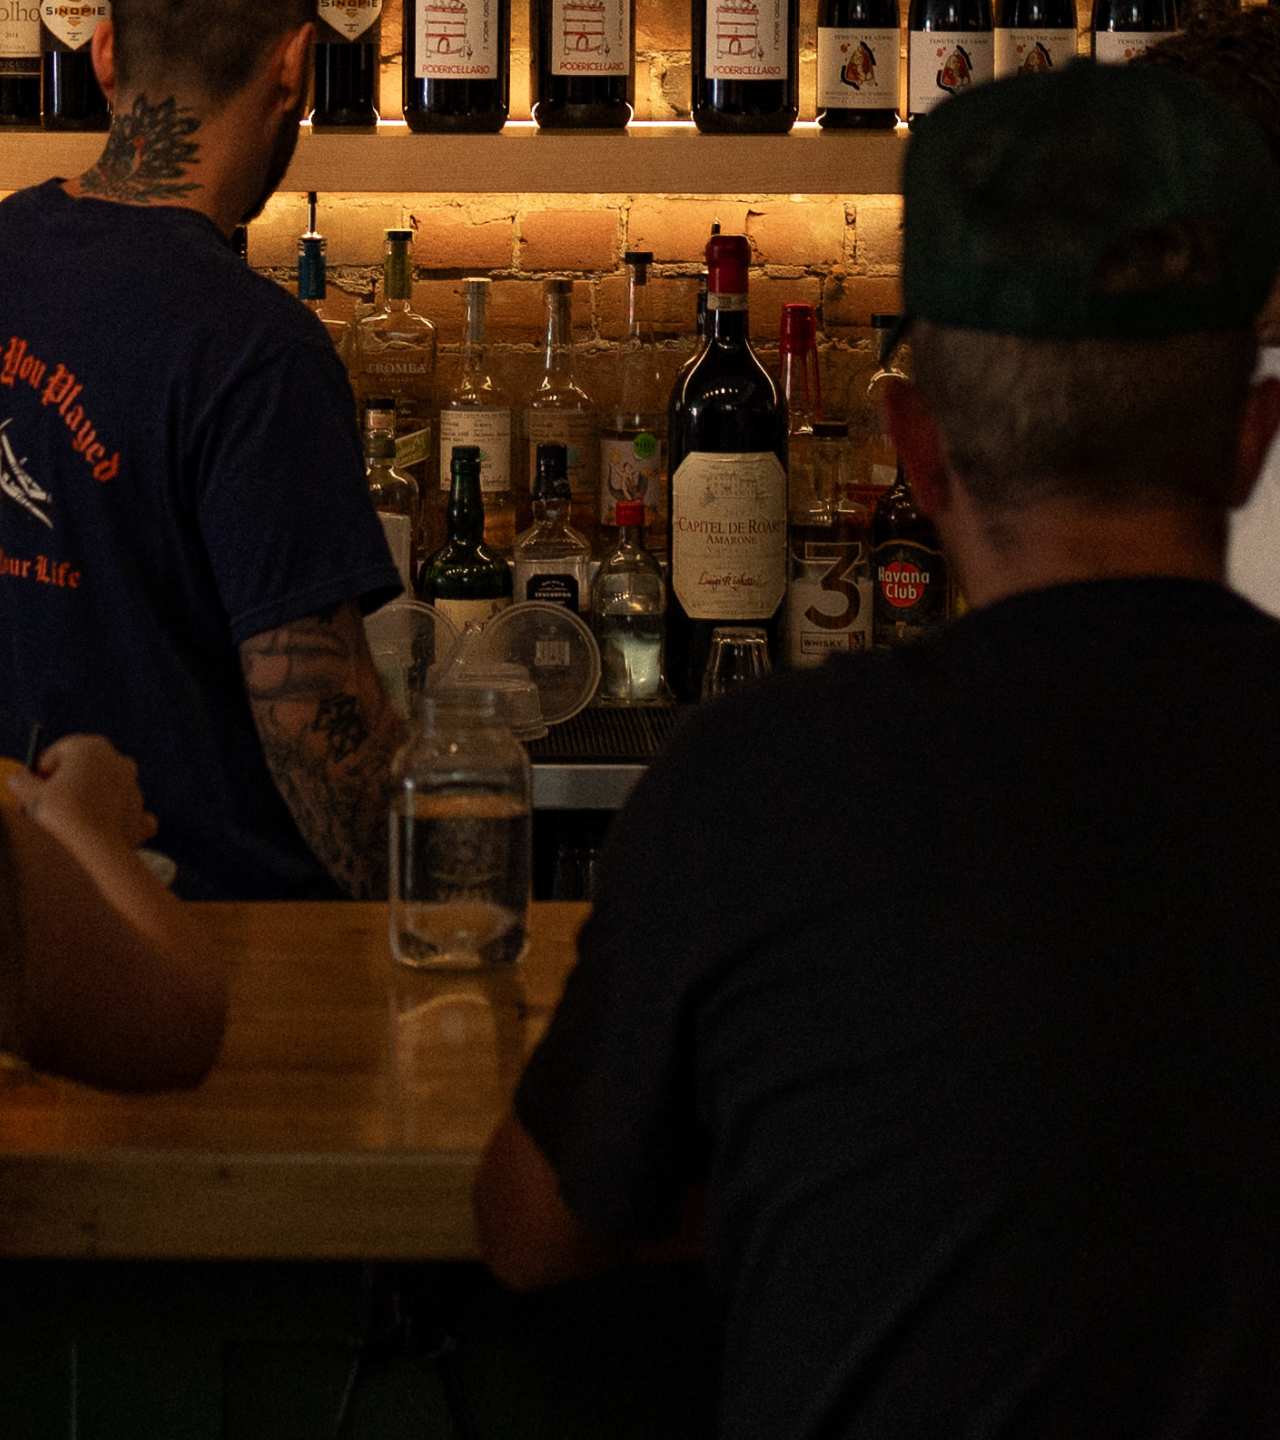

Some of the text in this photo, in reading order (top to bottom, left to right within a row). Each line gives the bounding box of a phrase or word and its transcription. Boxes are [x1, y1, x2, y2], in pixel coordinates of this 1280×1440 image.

[46, 6, 106, 16] SINOPIE
[0, 336, 48, 391] You
[41, 362, 122, 485] Played
[679, 517, 725, 534] CAPITEL
[706, 535, 757, 545] AMARONE
[35, 553, 82, 590] Life
[878, 565, 930, 584] Havana
[805, 542, 862, 631] 3
[885, 584, 917, 599] Club
[804, 640, 842, 648] WHISKY
